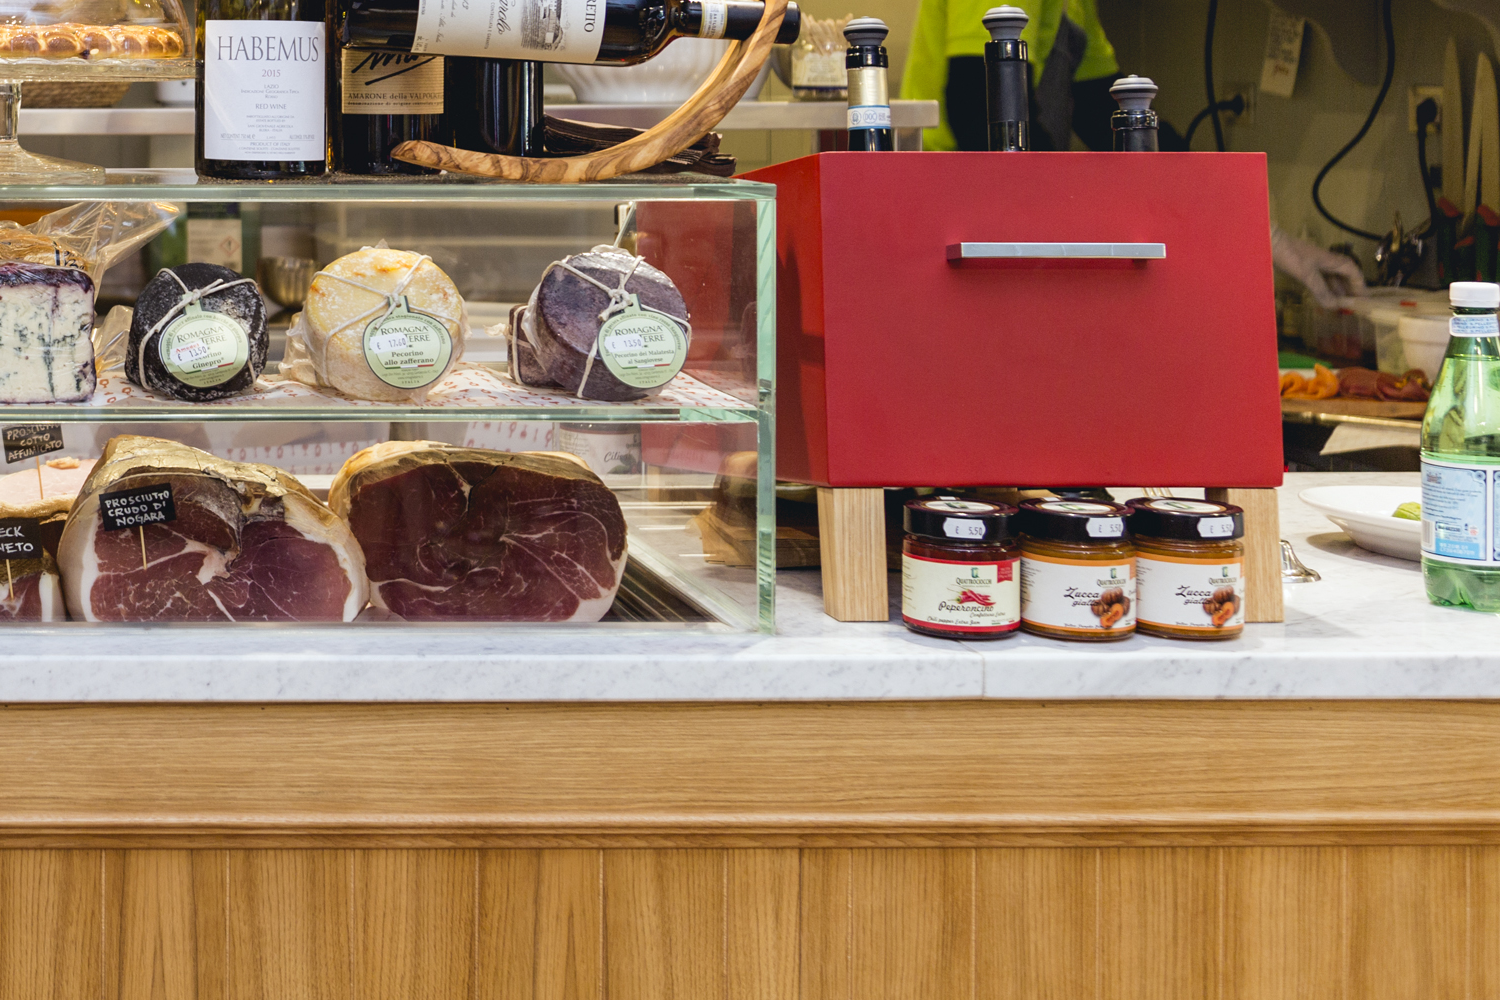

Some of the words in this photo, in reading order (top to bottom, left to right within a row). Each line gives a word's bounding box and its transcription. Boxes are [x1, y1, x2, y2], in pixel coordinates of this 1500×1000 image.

[217, 36, 319, 62] HABEMUS
[261, 69, 281, 77] 2015
[176, 326, 224, 343] ROMAGNA
[380, 325, 428, 335] ROMAGNA
[614, 325, 663, 336] ROMAGNA
[391, 350, 424, 358] Pecorino
[192, 359, 223, 369] Ginepro
[400, 357, 434, 365] zafferano
[20, 433, 50, 447] COTTO
[8, 440, 62, 461] AFFUMICATO
[104, 490, 170, 508] PROSCIUTTO
[108, 504, 148, 517] CRUDO
[115, 511, 166, 526] NOGARA
[1063, 587, 1100, 599] Zucca
[1175, 585, 1211, 598] Zucca
[938, 601, 994, 613] Peperoncino
